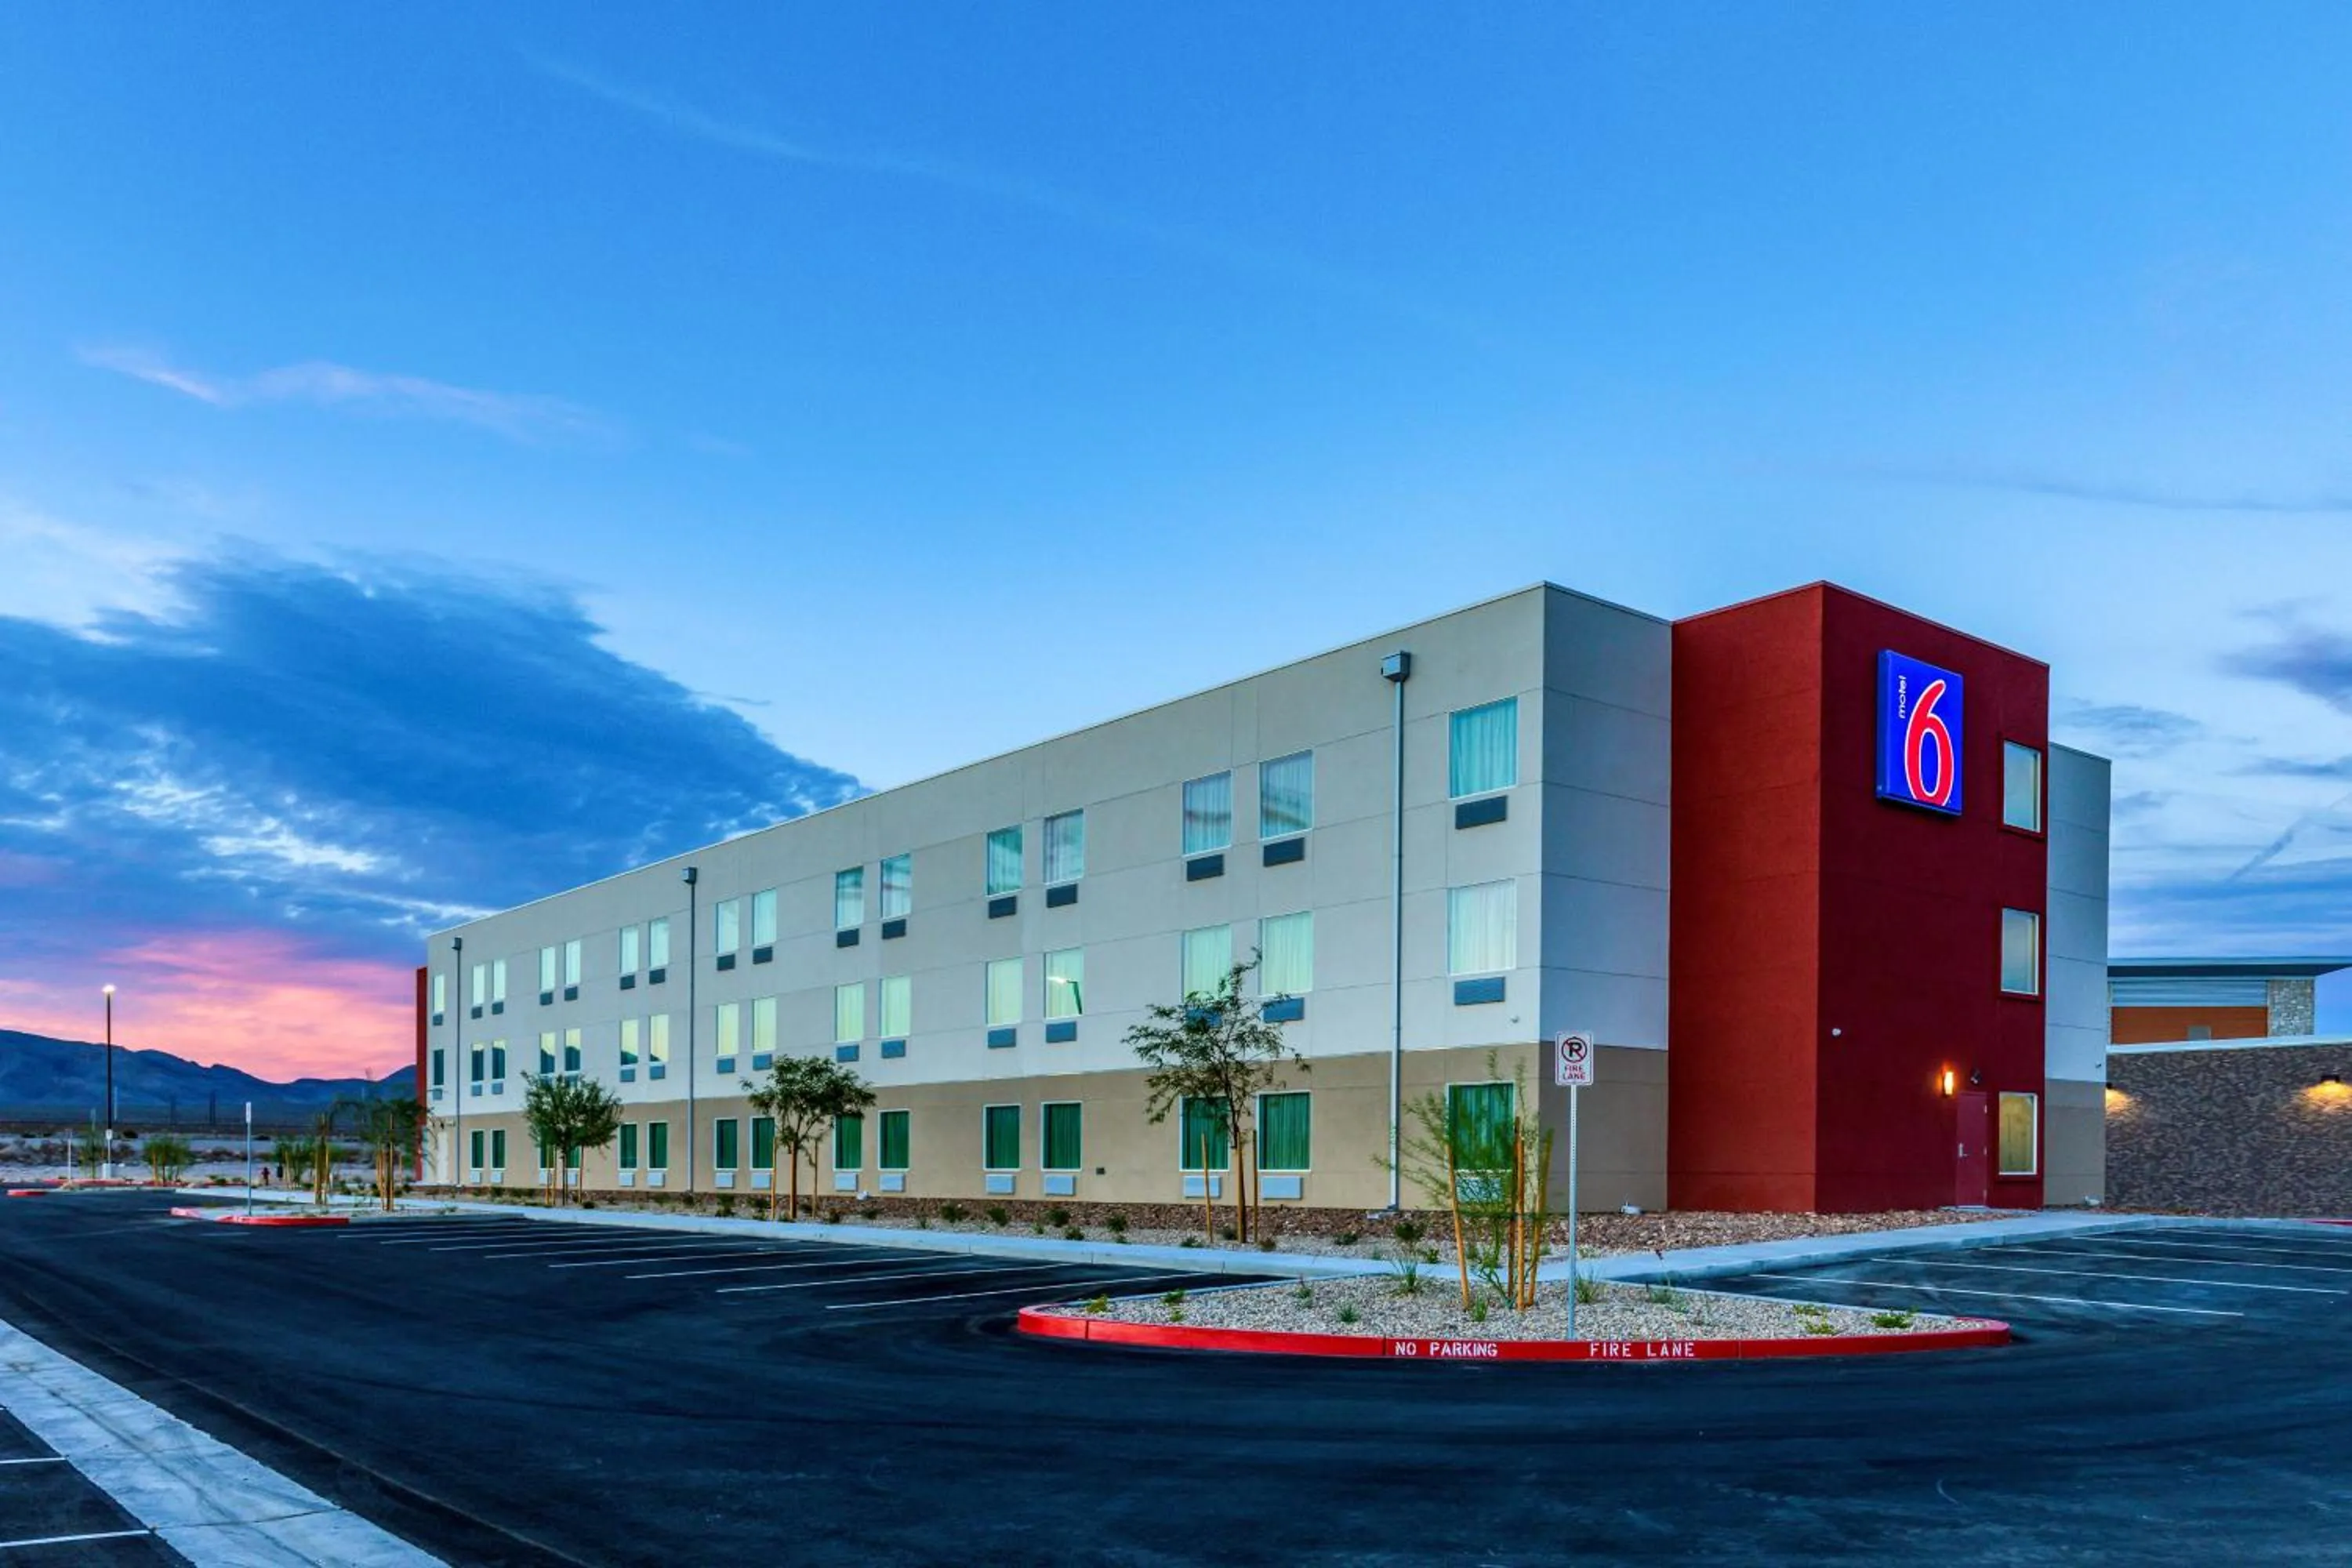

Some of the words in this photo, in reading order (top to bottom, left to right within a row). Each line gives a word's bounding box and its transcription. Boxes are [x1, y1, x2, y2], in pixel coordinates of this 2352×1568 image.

[1898, 675, 1907, 719] motel
[1904, 680, 1954, 806] 6
[1395, 1341, 1417, 1356] NO
[1429, 1341, 1497, 1356] PARKING
[1590, 1342, 1632, 1357] FIRE
[1647, 1342, 1694, 1357] LANE
